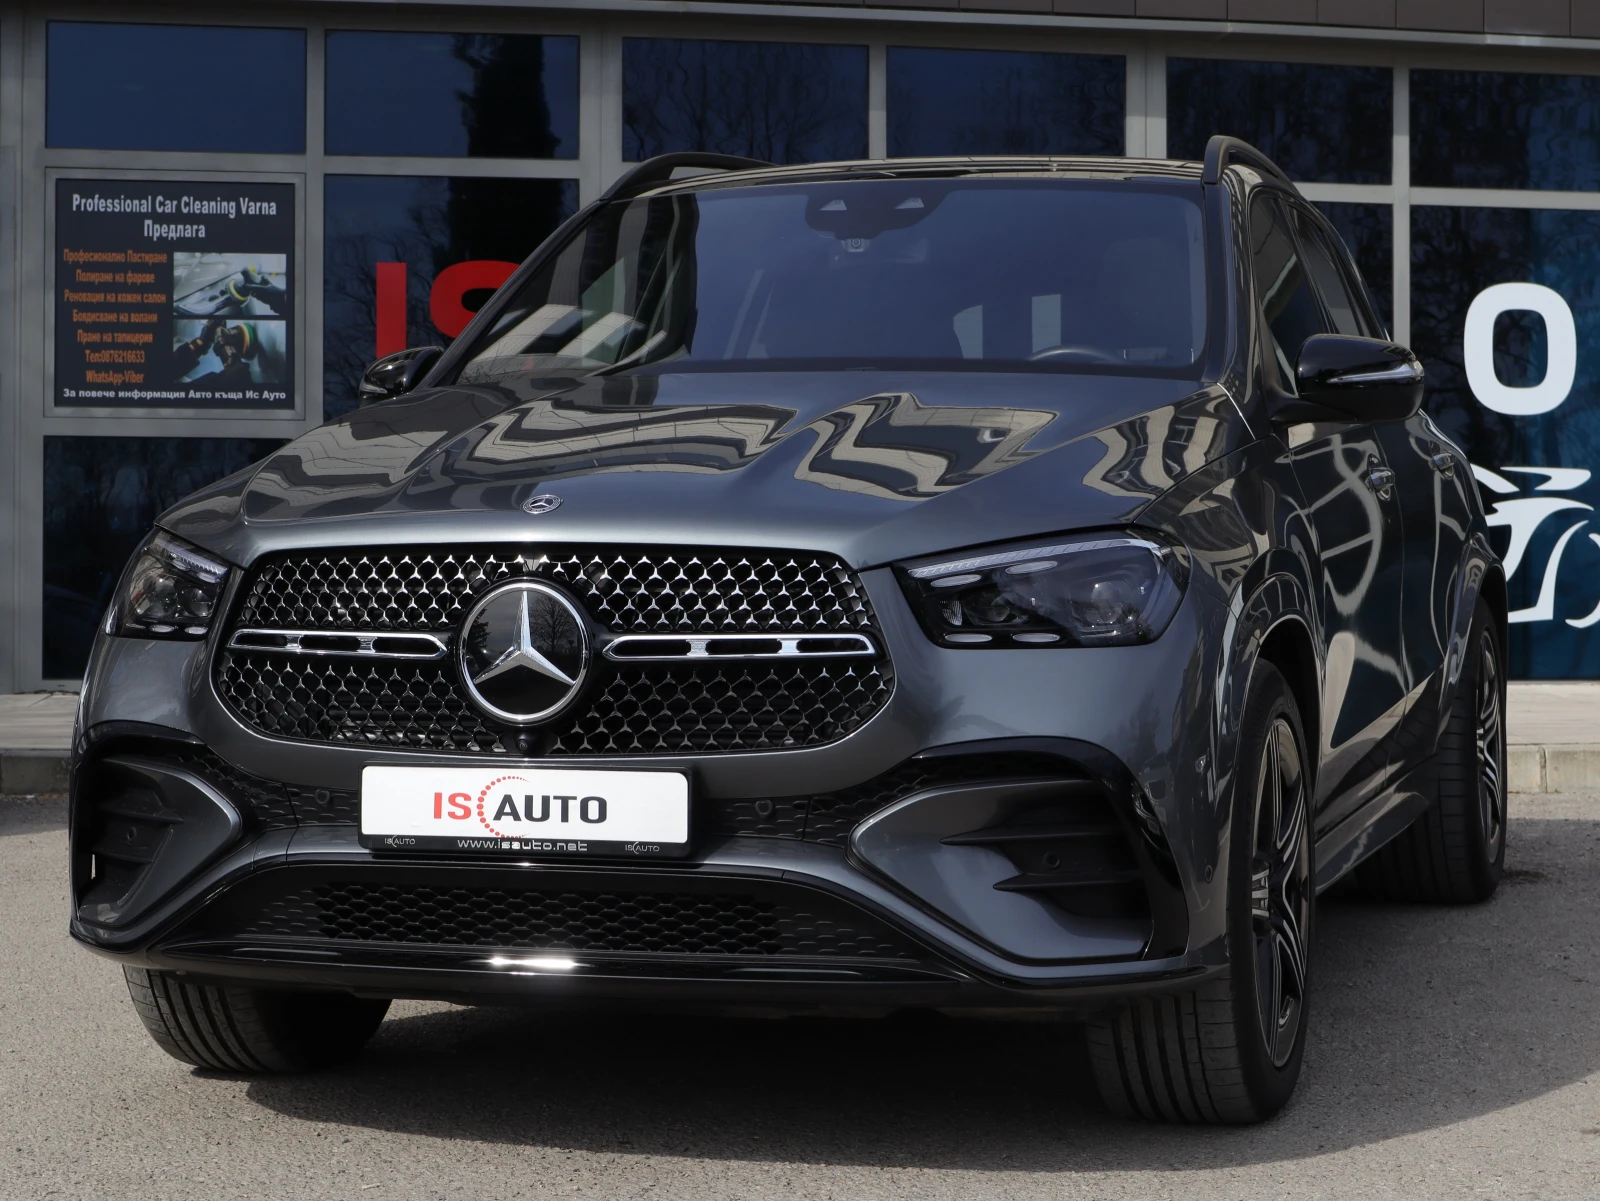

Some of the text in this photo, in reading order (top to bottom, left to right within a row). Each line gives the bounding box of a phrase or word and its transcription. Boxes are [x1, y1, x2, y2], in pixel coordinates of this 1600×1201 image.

[72, 193, 277, 218] Professional Car Cleaning Varna
[144, 219, 206, 241] Предлага
[63, 248, 125, 264] Професионално
[76, 269, 155, 285] Полиране на фарове
[64, 289, 104, 304] Реновация
[106, 293, 115, 302] на
[143, 294, 166, 303] салон
[72, 309, 117, 324] Боядисване
[119, 313, 128, 322] на
[77, 329, 153, 346] Пране на тапицерия
[85, 370, 145, 386] WhatsApp-Viber
[63, 388, 286, 400] За повече информация Авто къща Ис Ауто
[493, 794, 608, 824] AUTO
[457, 839, 588, 852] www.isauto.net
